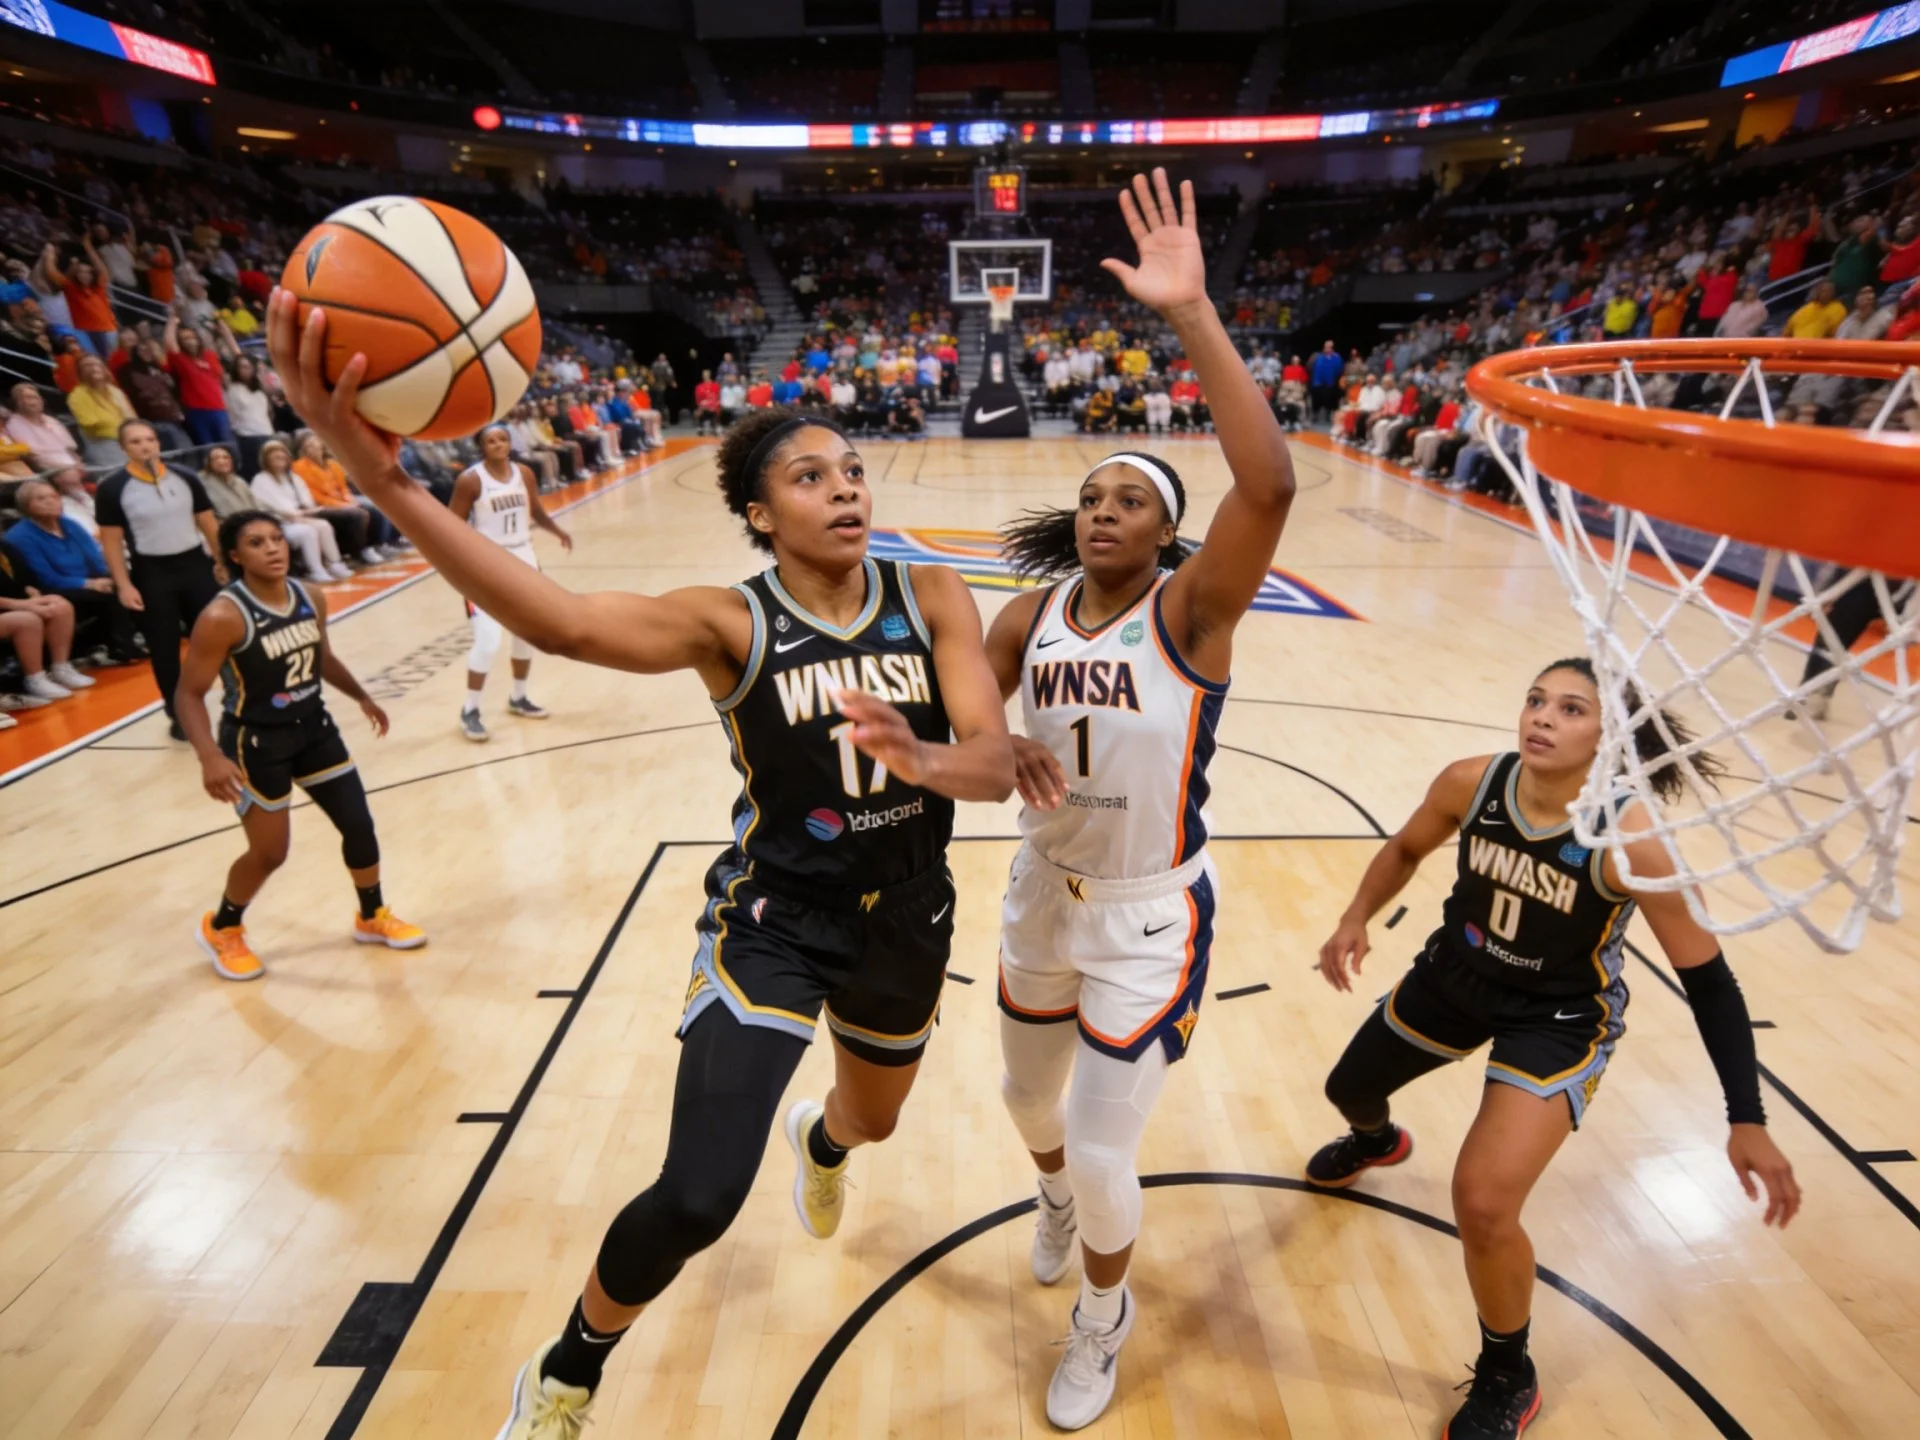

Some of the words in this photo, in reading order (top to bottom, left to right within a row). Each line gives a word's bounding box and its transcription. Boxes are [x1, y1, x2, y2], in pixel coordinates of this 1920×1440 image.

[285, 645, 315, 689] 22
[1030, 658, 1143, 714] WNSA
[1069, 714, 1091, 778] 1
[1488, 888, 1523, 943] 0
